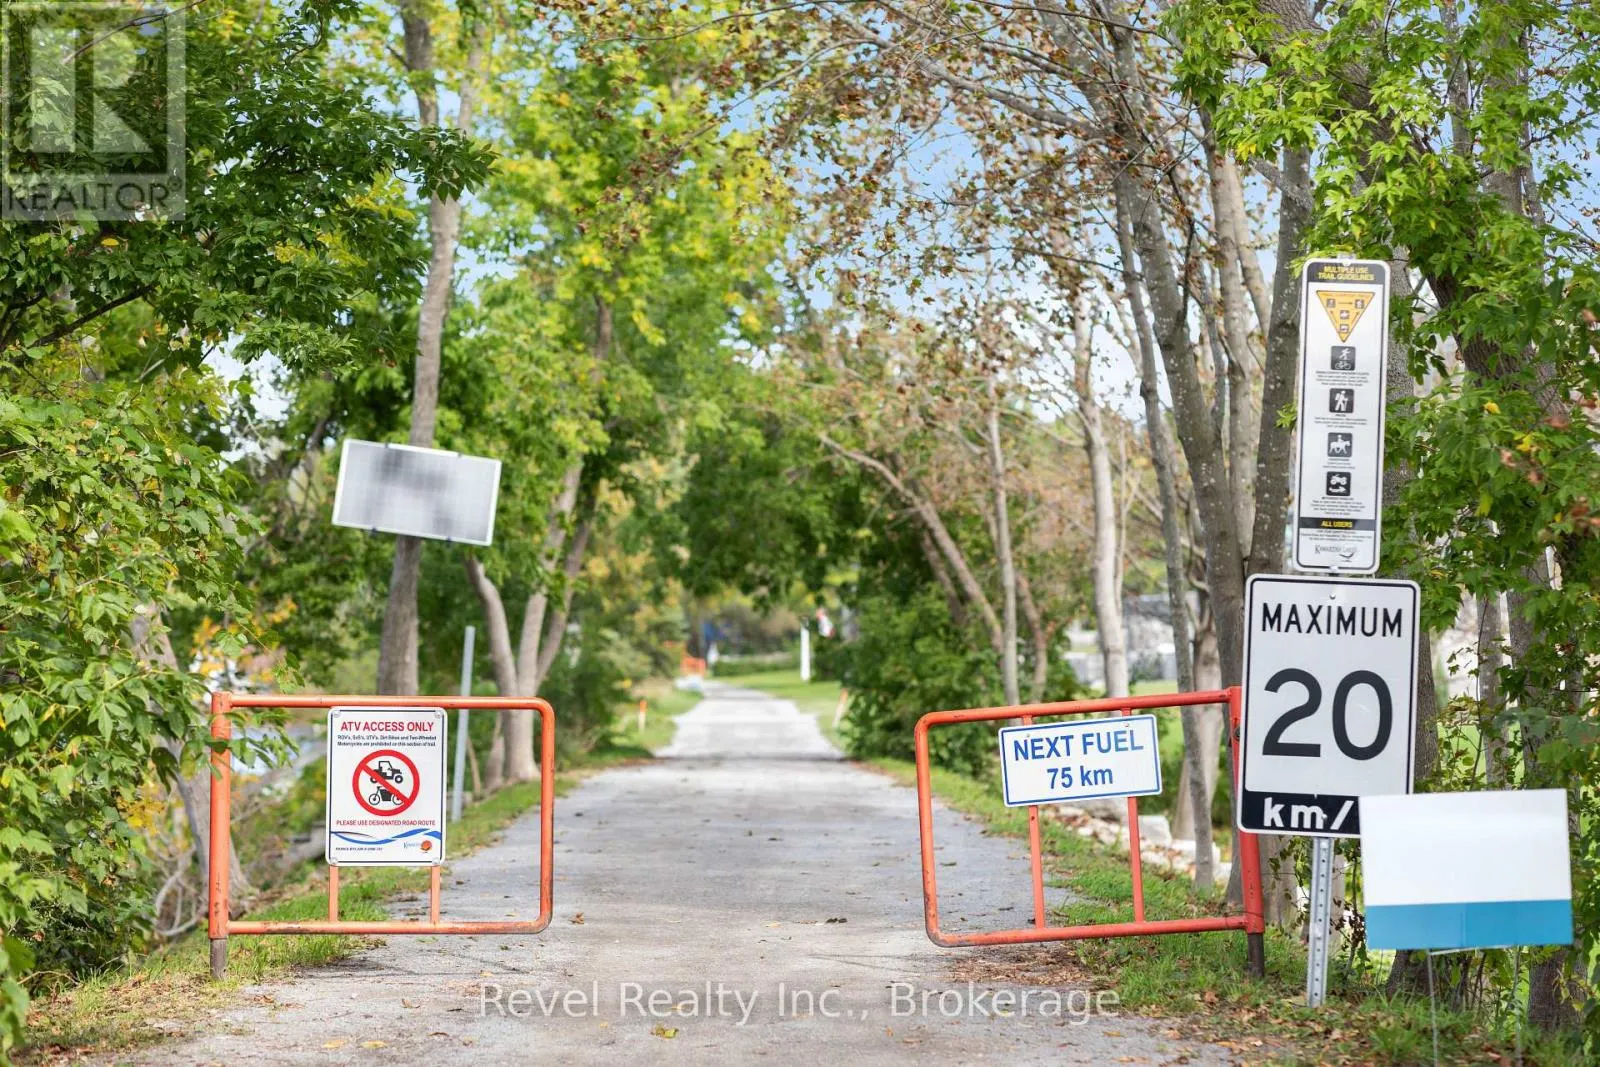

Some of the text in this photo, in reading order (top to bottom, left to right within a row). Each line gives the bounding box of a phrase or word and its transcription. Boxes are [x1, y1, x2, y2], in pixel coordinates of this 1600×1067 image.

[1318, 272, 1336, 280] TRAIL
[1262, 603, 1403, 638] MAXIMUM
[341, 721, 434, 732] ATV ACCESS ONLY
[1262, 668, 1393, 761] 20
[1014, 730, 1144, 761] NEXT FUEL
[1047, 765, 1113, 789] 75 km
[1263, 797, 1355, 830] km/
